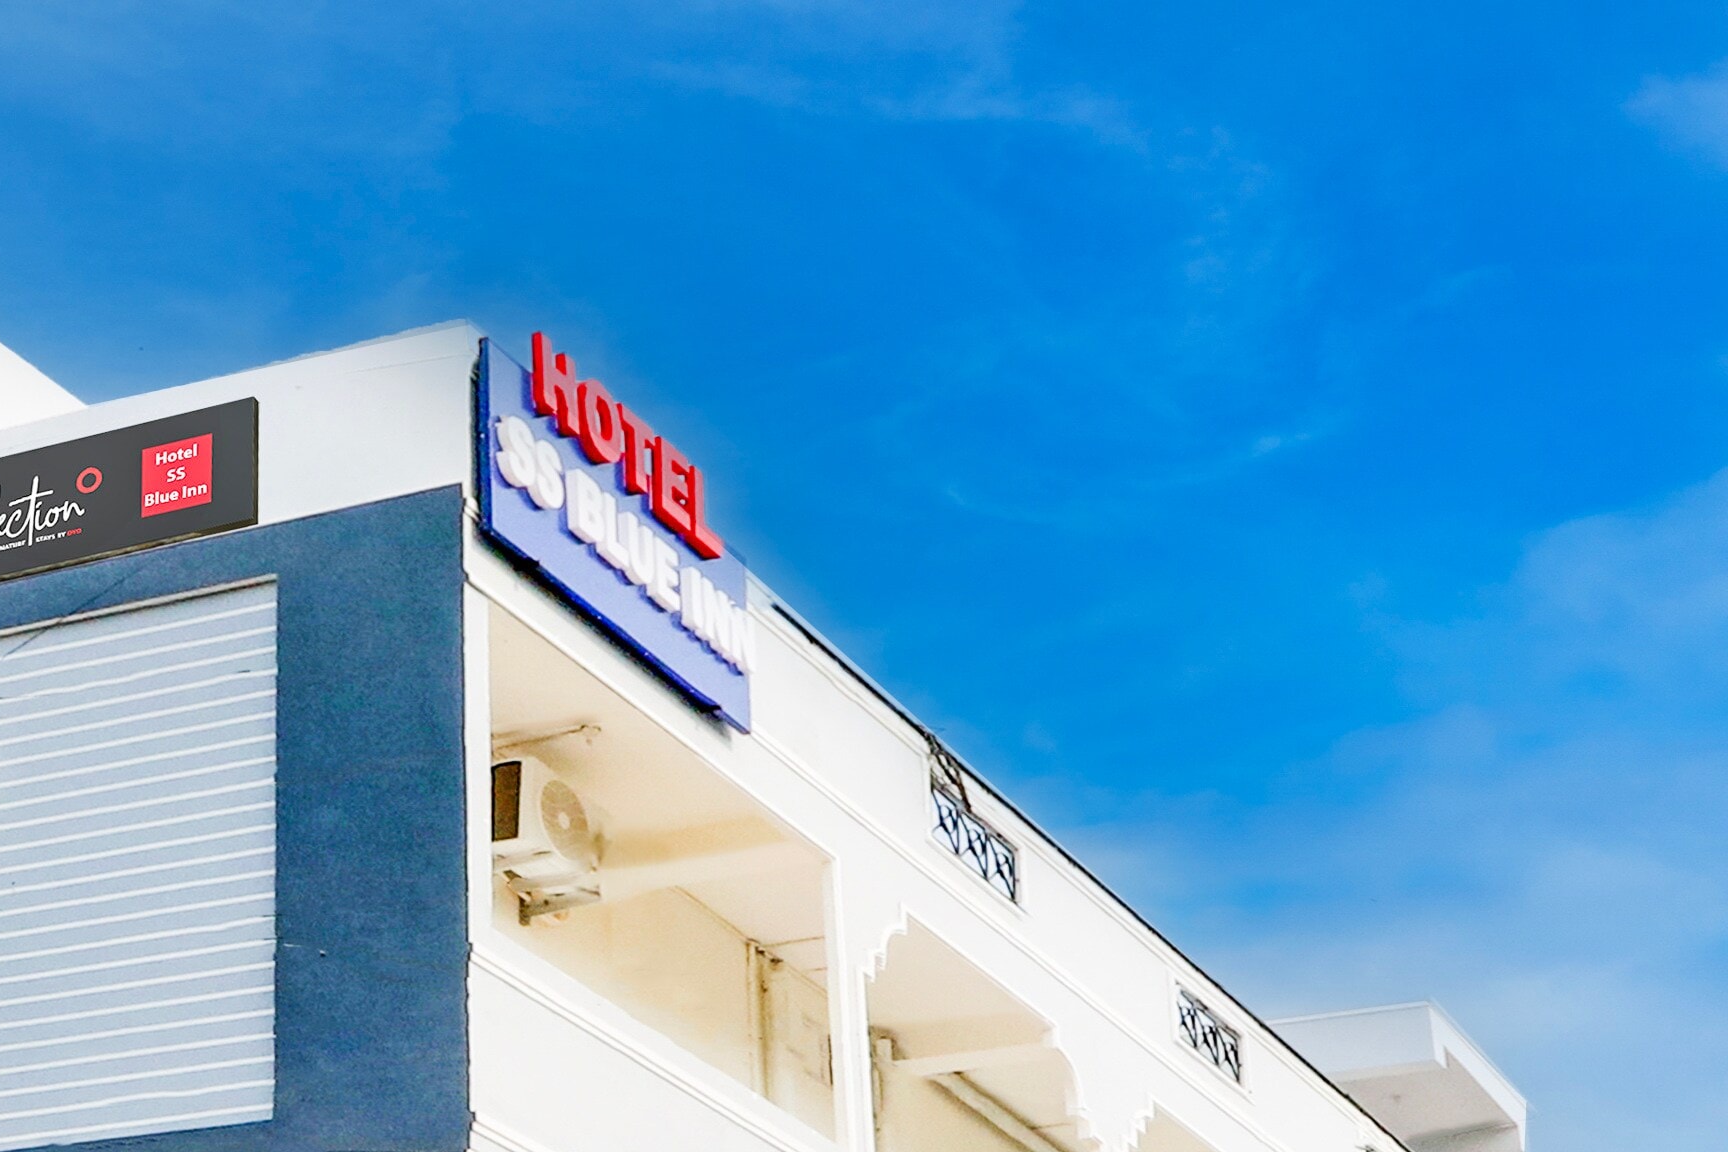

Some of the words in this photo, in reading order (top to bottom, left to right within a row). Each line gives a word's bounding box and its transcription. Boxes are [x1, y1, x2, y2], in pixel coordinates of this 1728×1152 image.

[155, 443, 198, 465] Hotel
[532, 331, 723, 558] HOTEL
[166, 466, 186, 482] SS
[144, 491, 179, 507] Blue
[181, 484, 208, 498] Inn
[496, 415, 565, 510] SS
[566, 467, 680, 613] BLUE
[680, 566, 757, 674] INN
